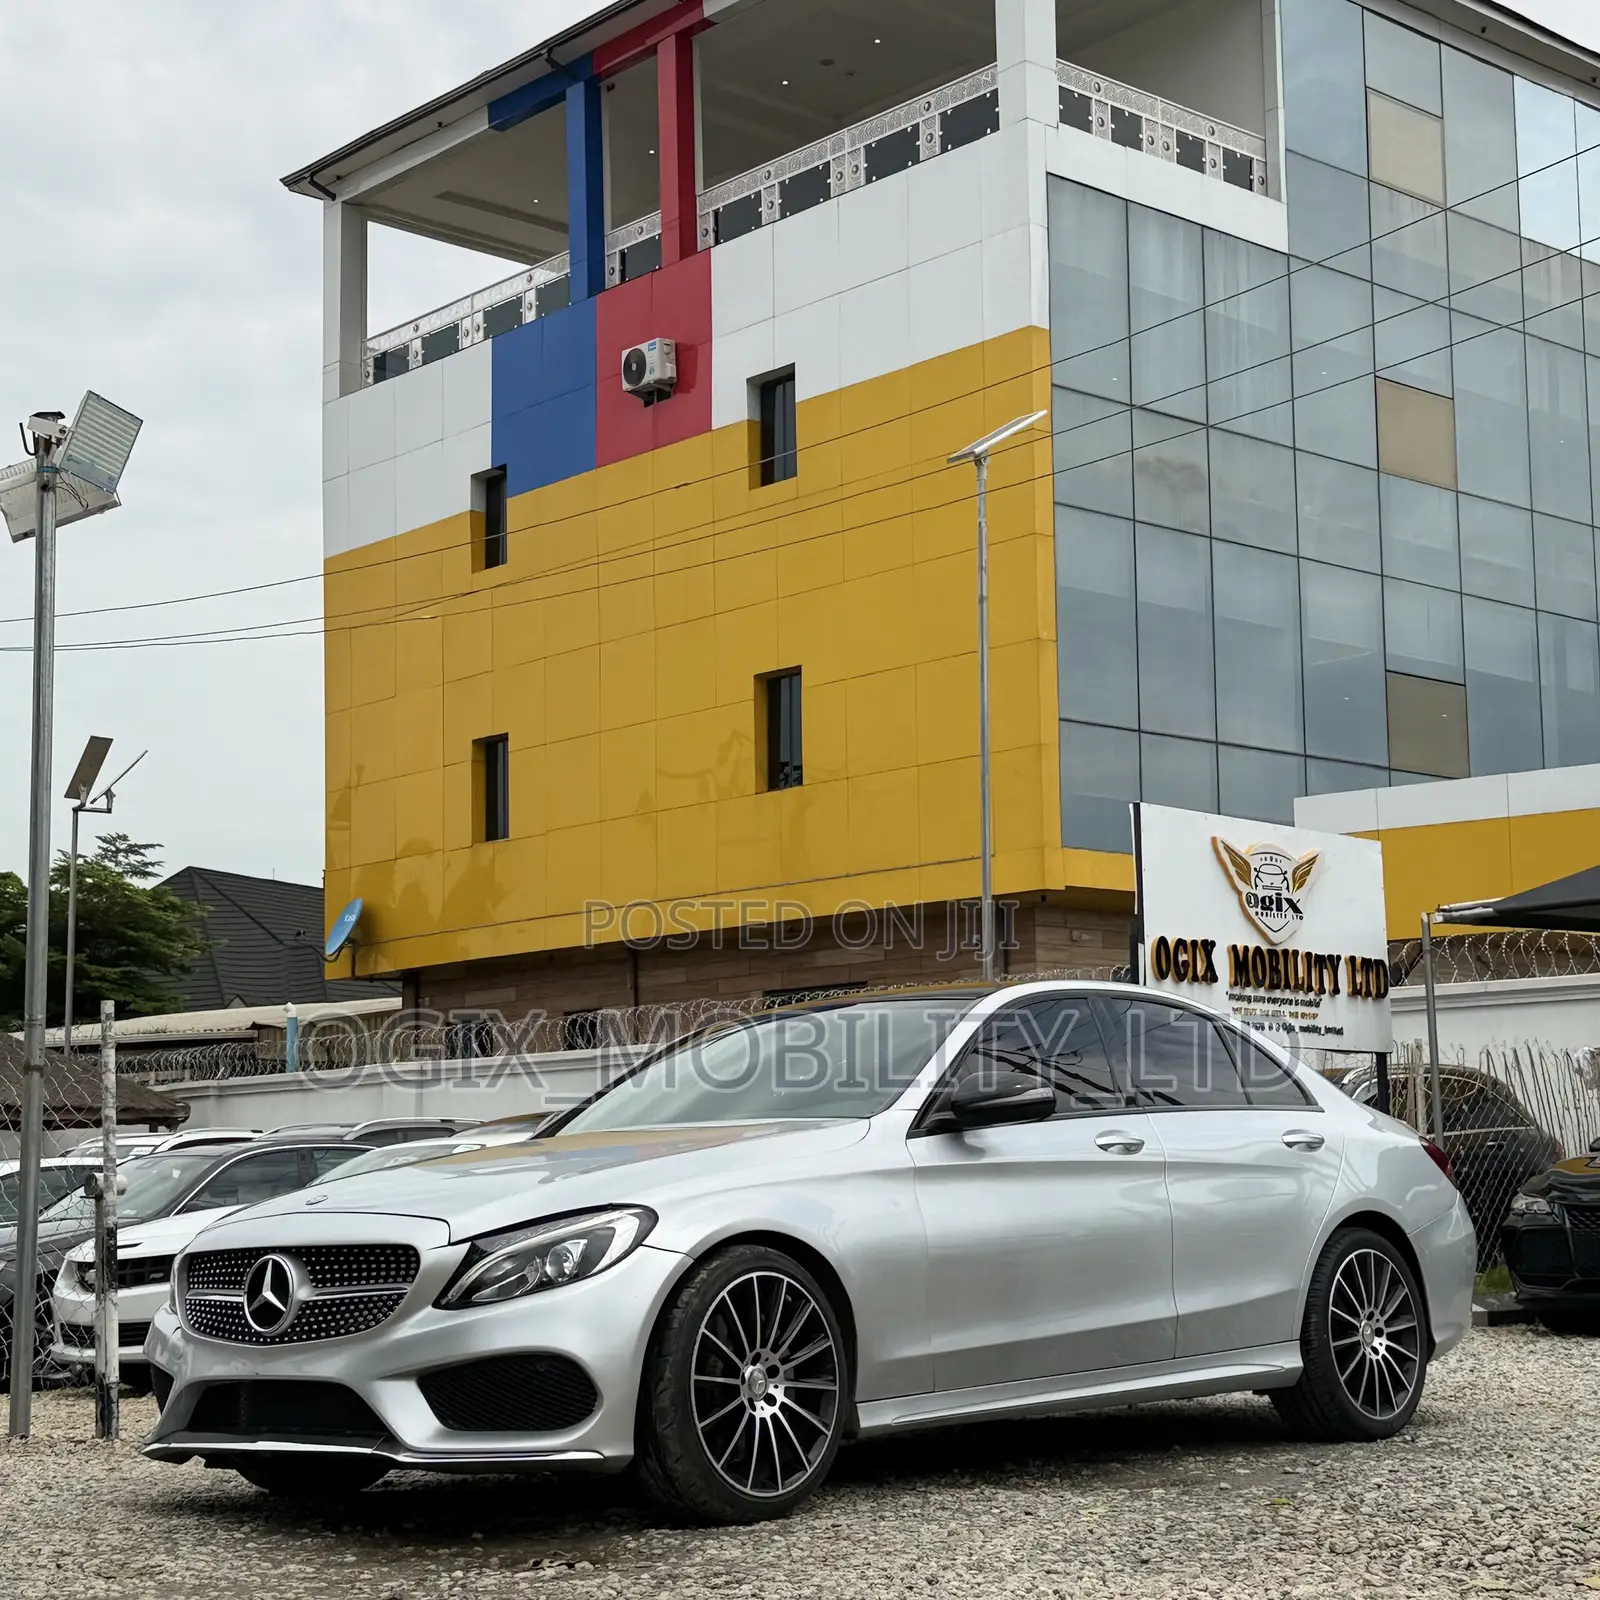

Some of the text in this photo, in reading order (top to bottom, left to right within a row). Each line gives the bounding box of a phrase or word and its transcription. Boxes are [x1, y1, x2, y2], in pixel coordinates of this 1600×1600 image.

[1151, 935, 1389, 999] OGIX MOBILITY LTD
